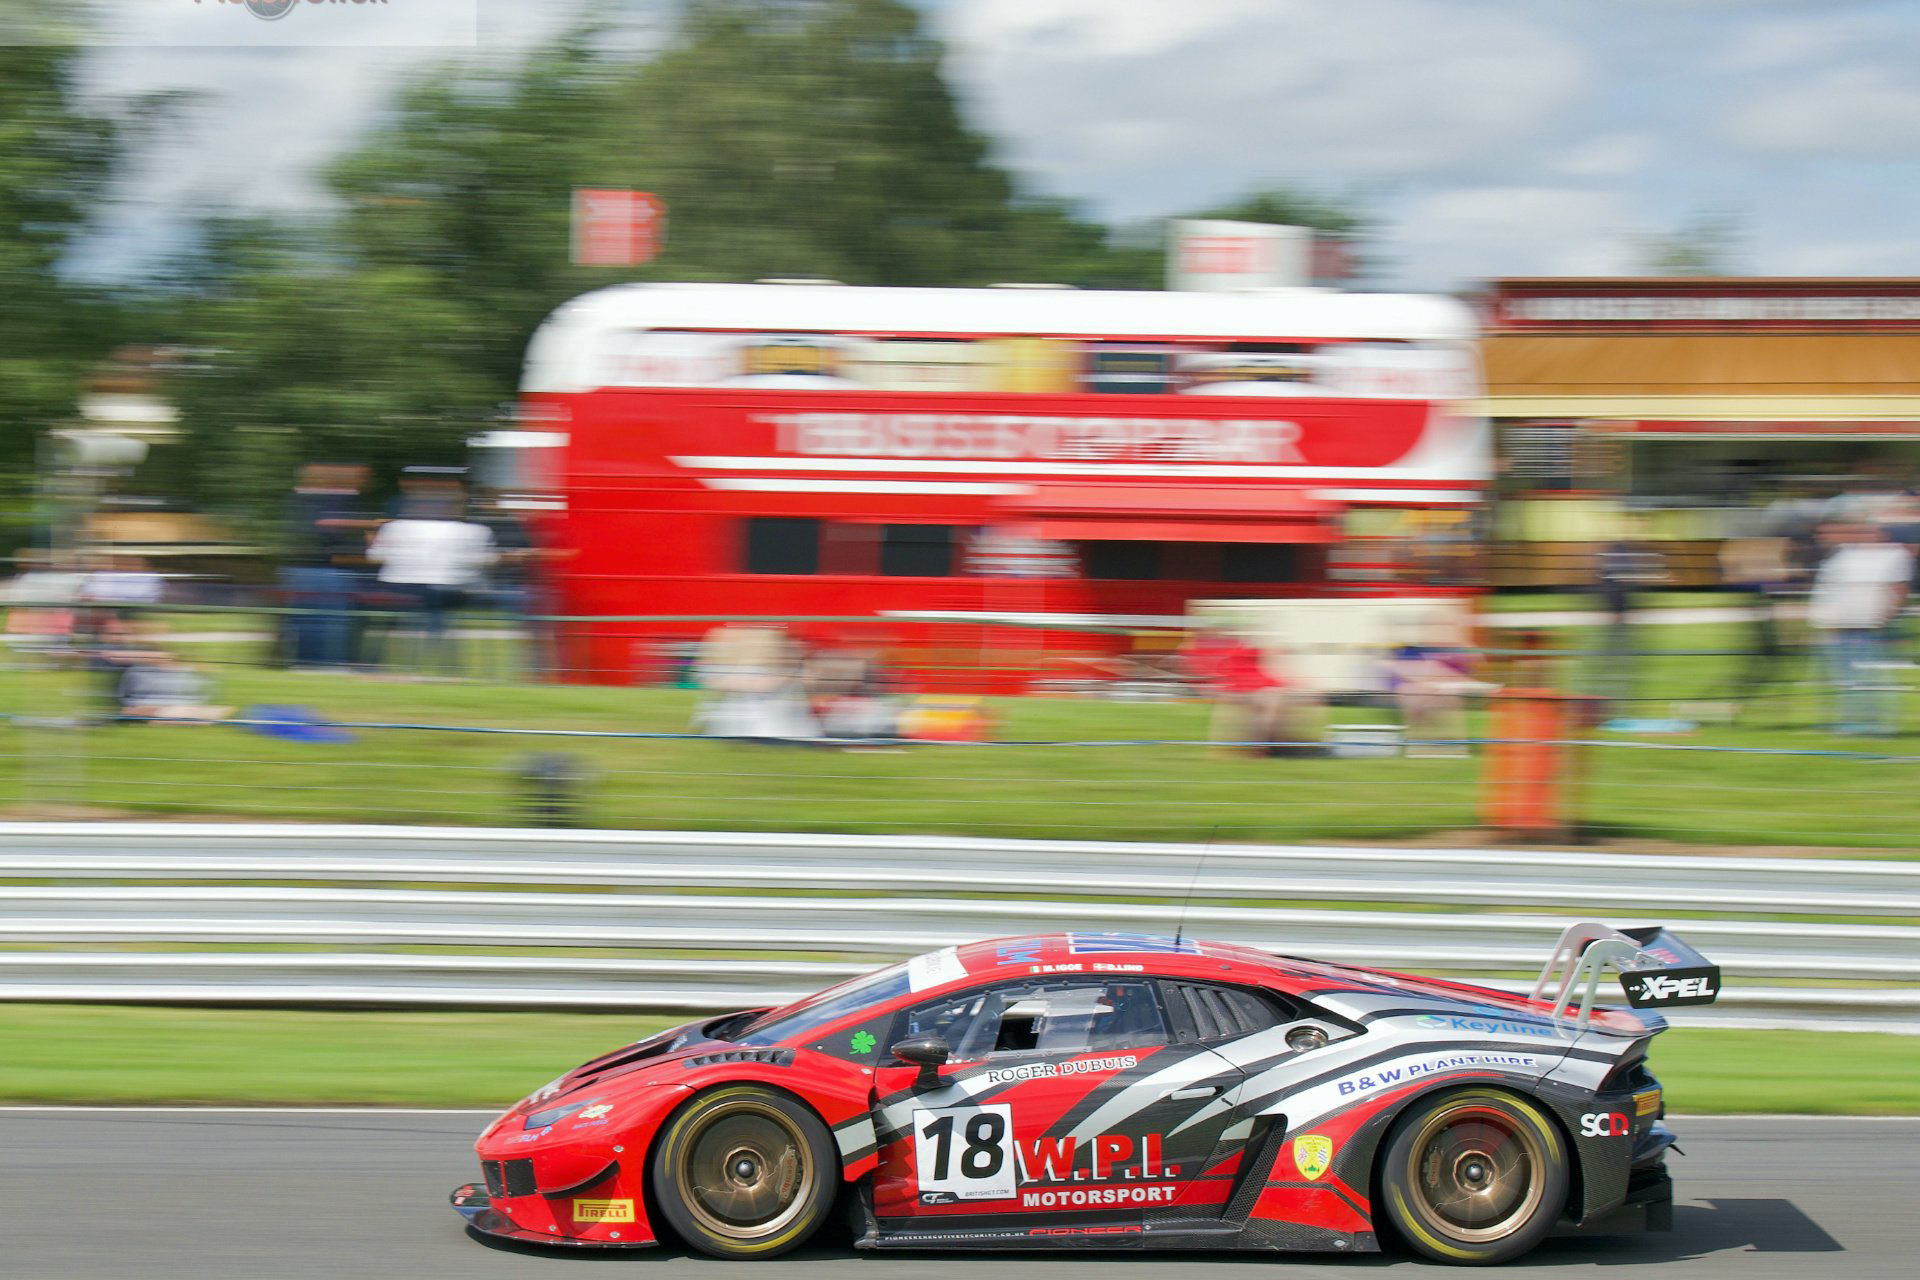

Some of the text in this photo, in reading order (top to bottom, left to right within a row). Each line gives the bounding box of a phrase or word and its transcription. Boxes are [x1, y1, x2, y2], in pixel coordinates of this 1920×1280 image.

[1638, 976, 1715, 1001] XPEL
[1451, 1017, 1552, 1036] Keyline
[988, 1056, 1136, 1083] ROGER DUBUIS
[1408, 1056, 1477, 1076] PLANT
[1484, 1056, 1535, 1067] HIRE
[922, 1112, 1005, 1181] 18
[1014, 1133, 1181, 1182] W.P.I.
[1023, 1186, 1176, 1207] MOTORSPORT
[578, 1203, 627, 1218] PIRELLI
[1028, 1225, 1142, 1237] PIONEER
